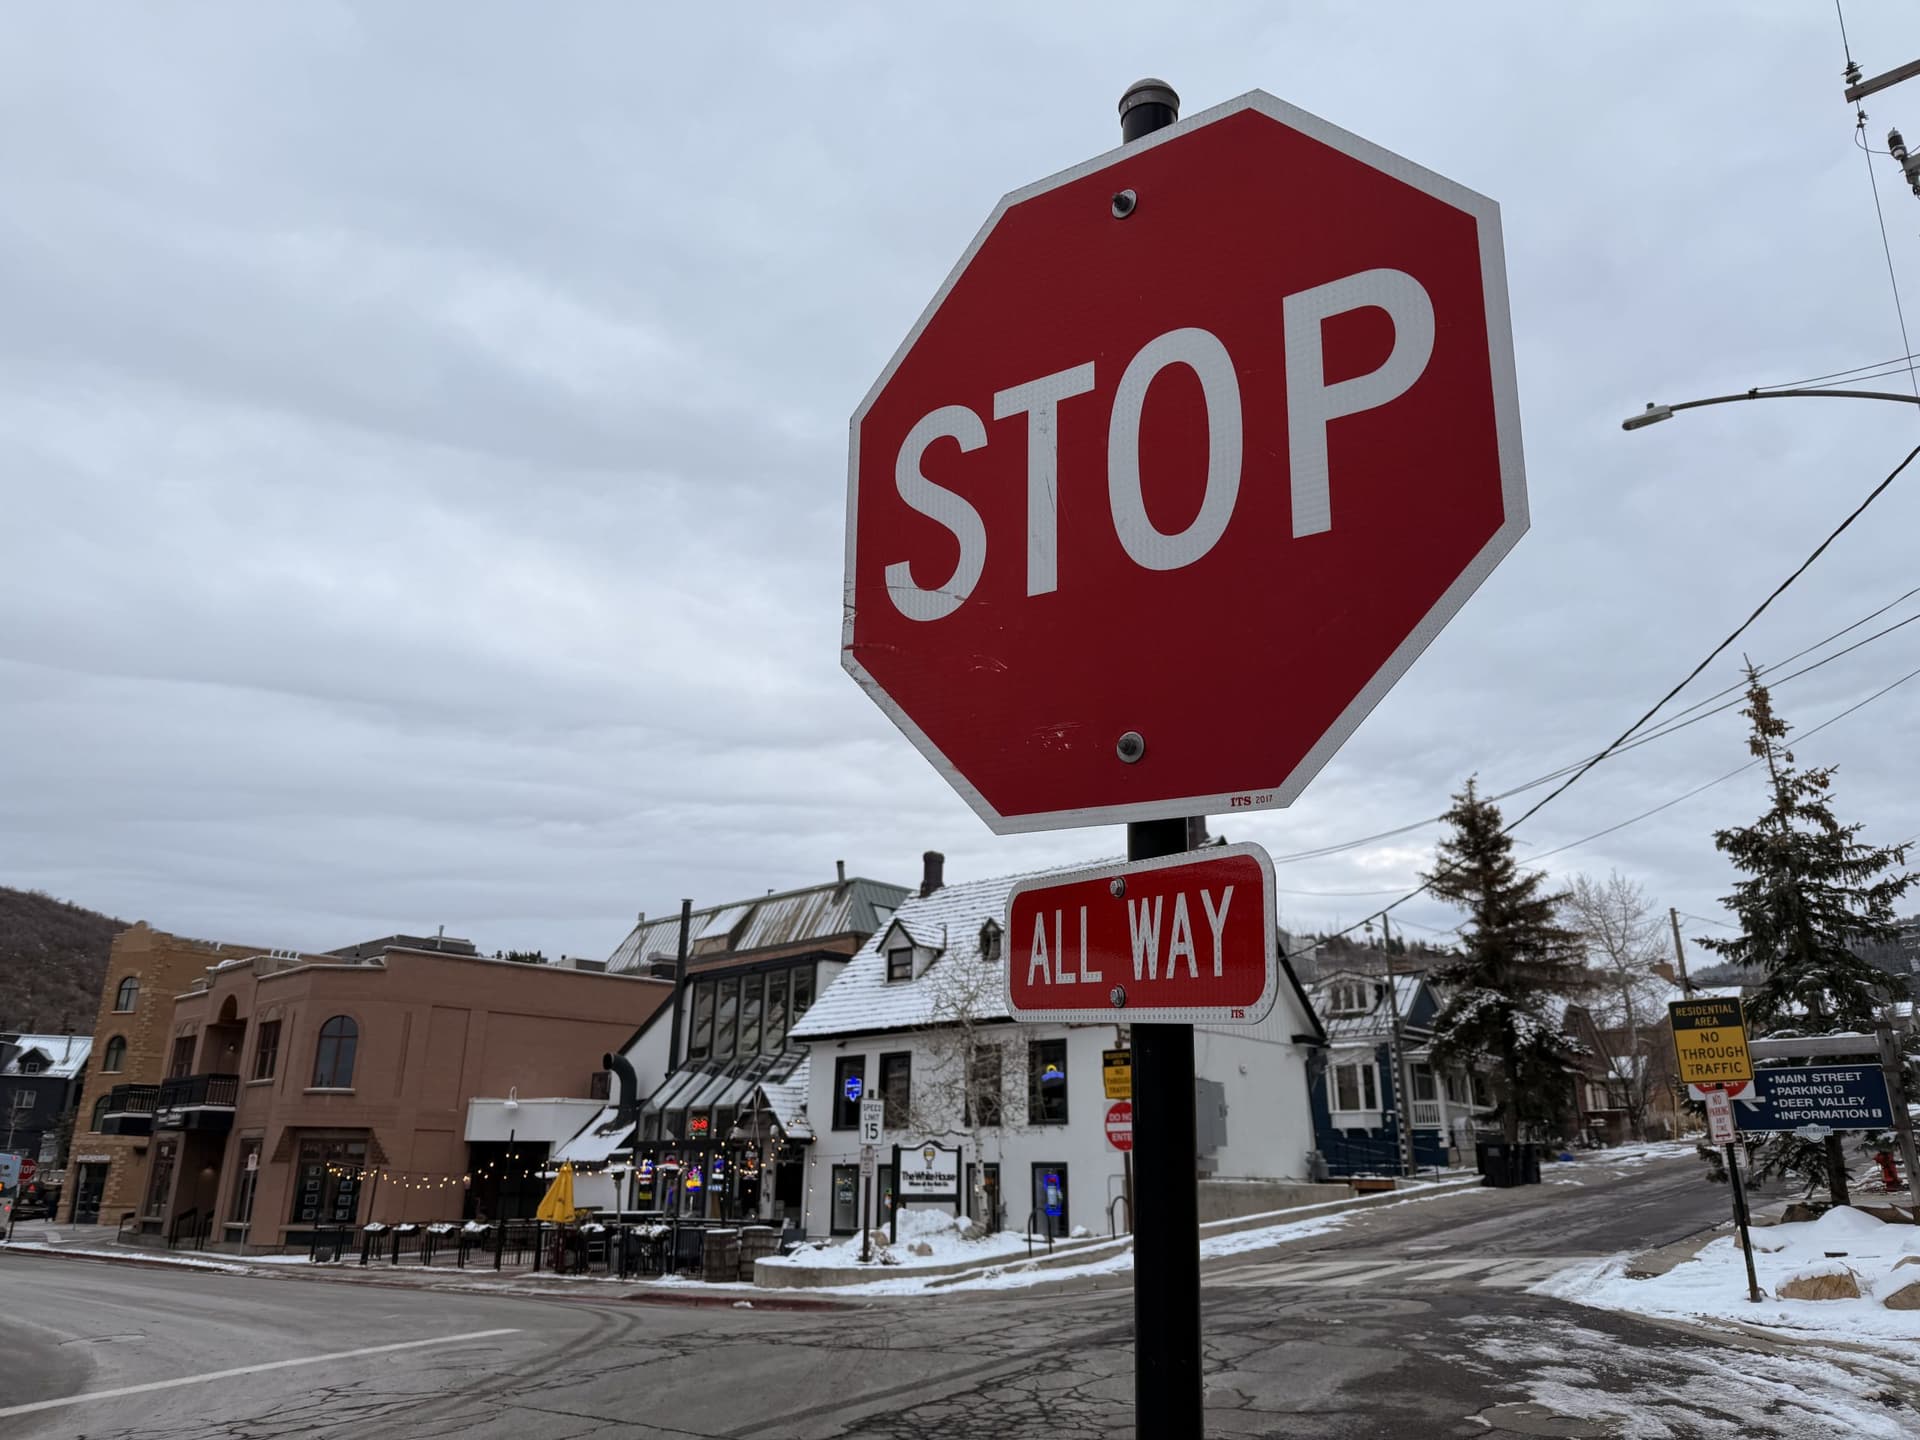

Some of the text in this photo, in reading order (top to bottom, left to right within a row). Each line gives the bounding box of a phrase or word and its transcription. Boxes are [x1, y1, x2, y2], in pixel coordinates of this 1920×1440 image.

[885, 268, 1436, 622] STOP
[1231, 795, 1272, 807] ITS 2017
[1027, 885, 1235, 986] ALL WAY
[1231, 1009, 1245, 1018] ITS
[1675, 1004, 1734, 1016] RESIDENTIAL
[1694, 1016, 1719, 1026] AREA
[1700, 1031, 1719, 1043] NO
[1681, 1046, 1744, 1060] THROUGH
[1688, 1062, 1742, 1075] TRAFFIC
[1775, 1072, 1862, 1084] MAIN STREET
[1777, 1085, 1833, 1096] PARKING
[1712, 1094, 1722, 1105] NO
[1779, 1096, 1866, 1108] DEER VALLEY
[863, 1103, 882, 1112] SPEED
[864, 1112, 880, 1121] LIMIT
[1109, 1113, 1121, 1121] DO
[1781, 1109, 1870, 1120] INFORMATION
[865, 1123, 879, 1140] 15
[901, 1171, 956, 1181] The White House
